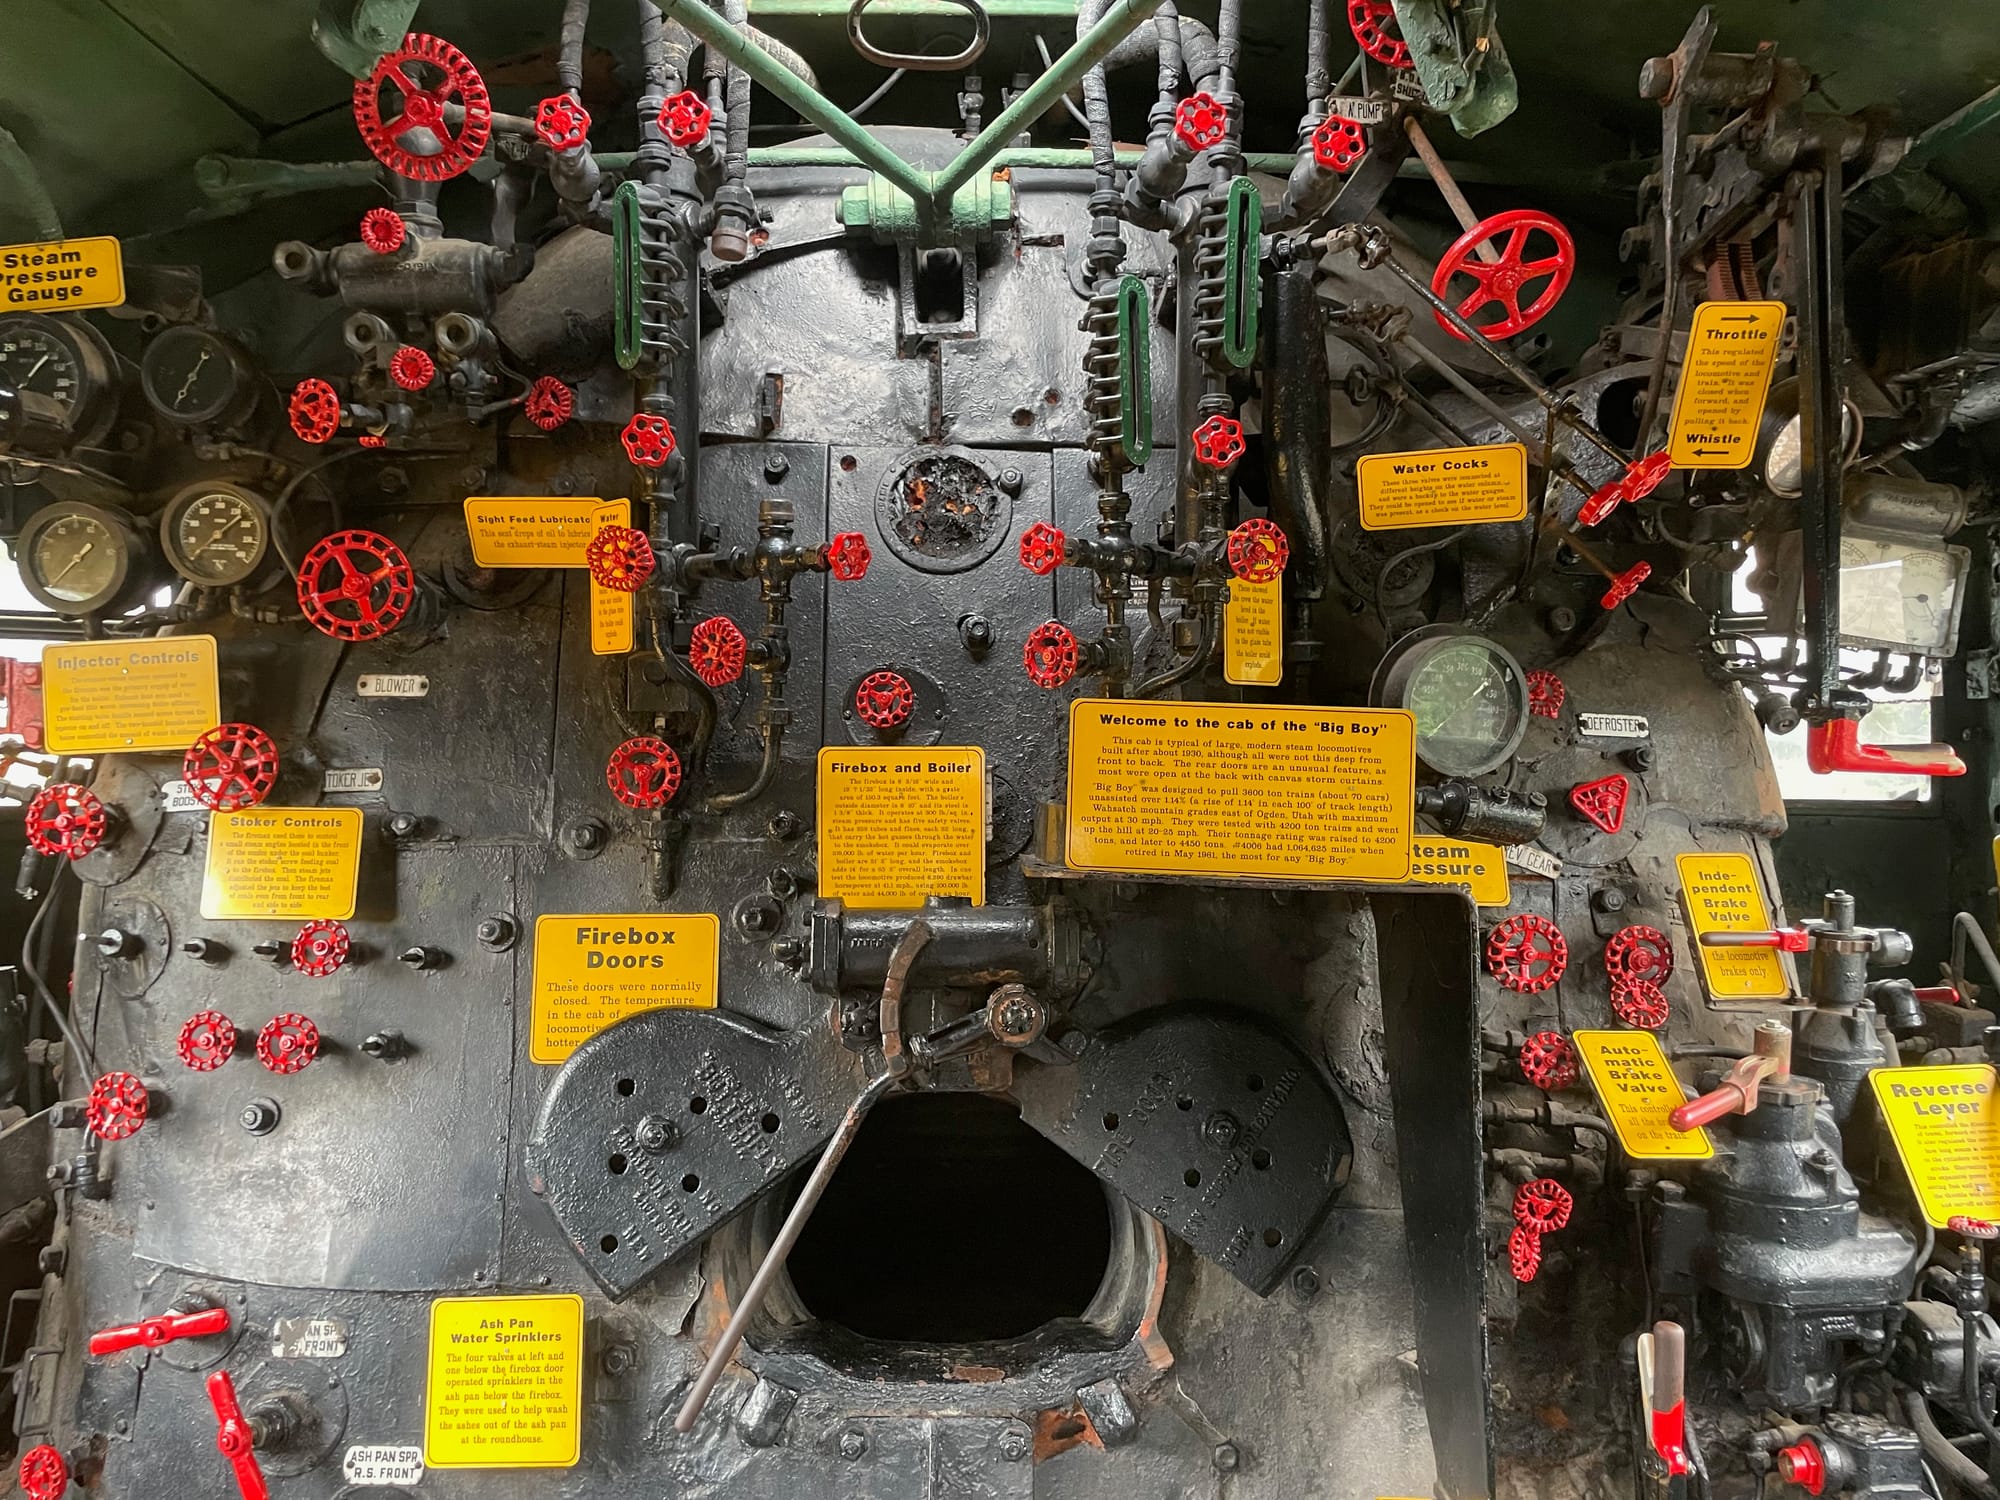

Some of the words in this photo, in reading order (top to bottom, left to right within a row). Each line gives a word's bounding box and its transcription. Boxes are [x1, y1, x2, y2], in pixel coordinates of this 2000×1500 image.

[1357, 102, 1382, 119] PUMP
[4, 251, 81, 269] Steam
[8, 285, 83, 303] Gauge
[1704, 328, 1769, 339] Throttle
[1684, 433, 1742, 443] Whistle
[1392, 462, 1436, 474] Water
[1442, 457, 1488, 471] Cocks
[476, 515, 505, 524] Sight
[508, 515, 535, 523] Feed
[538, 515, 590, 523] Lubricato
[599, 513, 620, 523] Water
[57, 655, 121, 671] Injector
[129, 651, 201, 666] Controls
[374, 677, 415, 694] BLOWER
[1099, 713, 1167, 726] Welcome
[1174, 716, 1189, 727] to
[1195, 717, 1220, 728] the
[1225, 718, 1254, 729] cab
[1260, 719, 1276, 730] of
[1283, 720, 1307, 731] the
[1314, 721, 1344, 735] "Big
[1351, 722, 1387, 736] Boy"
[1587, 716, 1641, 732] DEFROSTER
[1112, 735, 1133, 744] This
[1136, 736, 1152, 745] cab
[1155, 738, 1163, 746] is
[1167, 738, 1201, 749] typical
[1202, 739, 1212, 747] of
[1247, 741, 1282, 750] modern
[1286, 743, 1314, 751] steam
[1317, 743, 1372, 753] locomotives
[1102, 745, 1123, 754] built
[1127, 746, 1150, 755] after
[1153, 747, 1179, 756] about
[1207, 749, 1249, 760] although
[1252, 751, 1266, 759] all
[1294, 753, 1309, 761] not
[1313, 753, 1331, 762] this
[1334, 754, 1358, 764] deep
[1359, 755, 1382, 764] from
[831, 762, 888, 773] Firebox
[894, 762, 921, 773] and
[927, 762, 974, 773] Boiler
[1097, 756, 1122, 765] front
[1173, 759, 1191, 767] The
[1220, 760, 1248, 769] doors
[1289, 763, 1329, 773] unusual
[1333, 763, 1370, 774] feature,
[1153, 770, 1177, 779] open
[1181, 770, 1191, 778] at
[1195, 770, 1211, 779] the
[1215, 770, 1238, 780] back
[1242, 771, 1264, 781] with
[1306, 775, 1336, 783] storm
[229, 816, 278, 827] Stoker
[282, 817, 343, 827] Controls
[1413, 843, 1470, 859] team
[1526, 852, 1553, 874] GEAR
[1412, 863, 1486, 876] essure
[1698, 871, 1737, 881] Inde-
[1692, 883, 1753, 895] pendent
[1703, 898, 1748, 908] Brake
[1708, 911, 1751, 922] Valve
[577, 926, 675, 945] Firebox
[587, 950, 664, 968] Doors
[1712, 951, 1725, 961] the
[1727, 951, 1770, 961] locomotive
[1719, 966, 1747, 977] brakes
[546, 982, 579, 991] These
[583, 982, 614, 991] doors
[619, 983, 645, 991] were
[650, 981, 702, 992] normally
[600, 995, 621, 1005] The
[625, 996, 695, 1006] temperature
[546, 1009, 559, 1019] in
[563, 1009, 581, 1019] the
[585, 1008, 605, 1019] cab
[608, 1008, 620, 1019] of
[545, 1037, 579, 1047] hotter
[1600, 1045, 1649, 1055] Auto-
[1604, 1058, 1655, 1067] matic
[1608, 1070, 1662, 1080] Brake
[1617, 1083, 1668, 1094] Valve
[1890, 1081, 1989, 1098] Reverse
[1913, 1101, 1980, 1116] Lever
[480, 1318, 504, 1329] Ash
[509, 1318, 533, 1328] Pan
[451, 1332, 489, 1343] Water
[495, 1331, 562, 1344] Sprinklers
[305, 1340, 338, 1352] FRONT
[446, 1352, 462, 1362] The
[466, 1352, 485, 1362] four
[487, 1351, 514, 1361] valves
[517, 1352, 526, 1361] at
[530, 1351, 545, 1360] left
[548, 1351, 564, 1360] and
[464, 1365, 489, 1374] below
[492, 1364, 506, 1373] the
[509, 1364, 541, 1373] firebox
[544, 1363, 564, 1372] door
[445, 1376, 484, 1388] operated
[487, 1375, 533, 1388] sprinklers
[536, 1375, 546, 1384] in
[548, 1375, 563, 1384] the
[445, 1391, 460, 1400] ash
[464, 1393, 480, 1402] pan
[483, 1390, 509, 1400] below
[512, 1390, 526, 1399] the
[438, 1405, 460, 1417] They
[463, 1407, 484, 1415] were
[487, 1404, 507, 1414] used
[511, 1405, 520, 1414] to
[523, 1404, 542, 1416] help
[545, 1403, 568, 1413] wash
[440, 1420, 453, 1430] the
[456, 1420, 480, 1429] ashes
[483, 1421, 498, 1429] out
[501, 1419, 511, 1429] of
[514, 1419, 528, 1429] the
[531, 1419, 547, 1429] ash
[550, 1421, 567, 1431] pan
[351, 1450, 372, 1462] ASH
[375, 1450, 396, 1462] PAN
[398, 1450, 418, 1462] SPR
[354, 1467, 377, 1479] R.S.
[379, 1467, 416, 1479] FRONT
